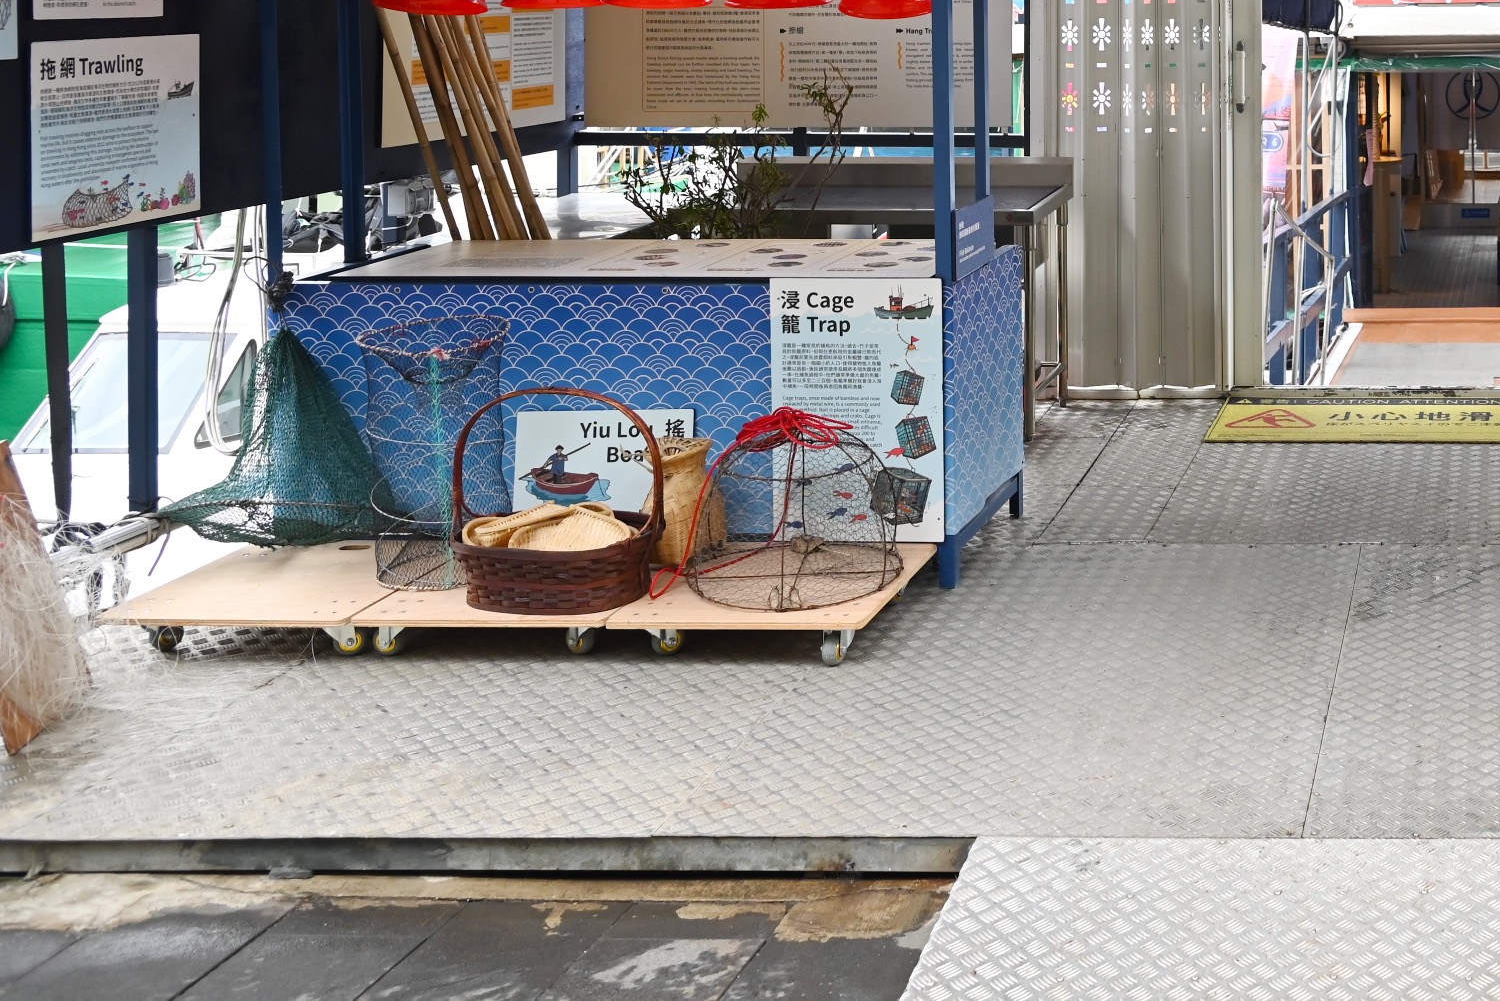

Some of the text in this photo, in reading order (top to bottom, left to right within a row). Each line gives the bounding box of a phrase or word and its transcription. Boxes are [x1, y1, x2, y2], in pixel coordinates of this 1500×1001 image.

[906, 28, 923, 36] Hang
[40, 55, 143, 80] 拖網 Trawling
[781, 290, 855, 312] 浸 Cage
[781, 314, 851, 336] 籠 Trap
[580, 421, 610, 439] Yiu
